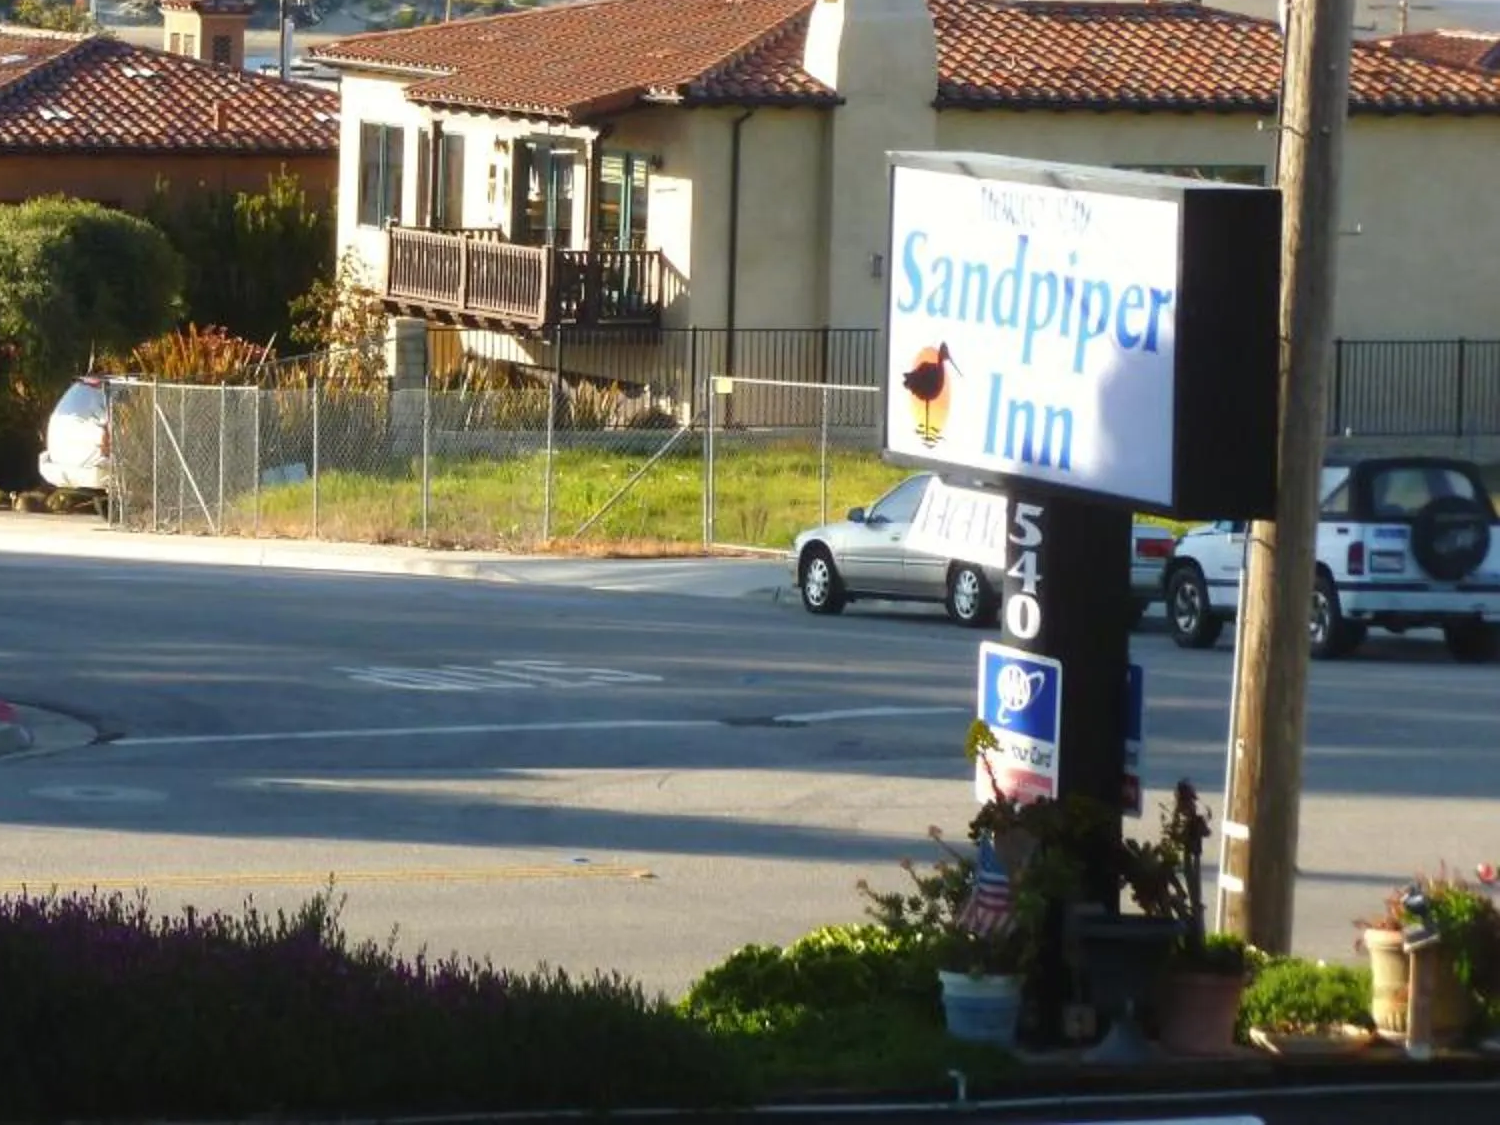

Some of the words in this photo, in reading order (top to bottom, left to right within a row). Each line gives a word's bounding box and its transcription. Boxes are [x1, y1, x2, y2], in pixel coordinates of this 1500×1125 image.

[897, 229, 1174, 374] Sandpiper
[982, 372, 1074, 472] Inn
[1007, 502, 1044, 640] 540
